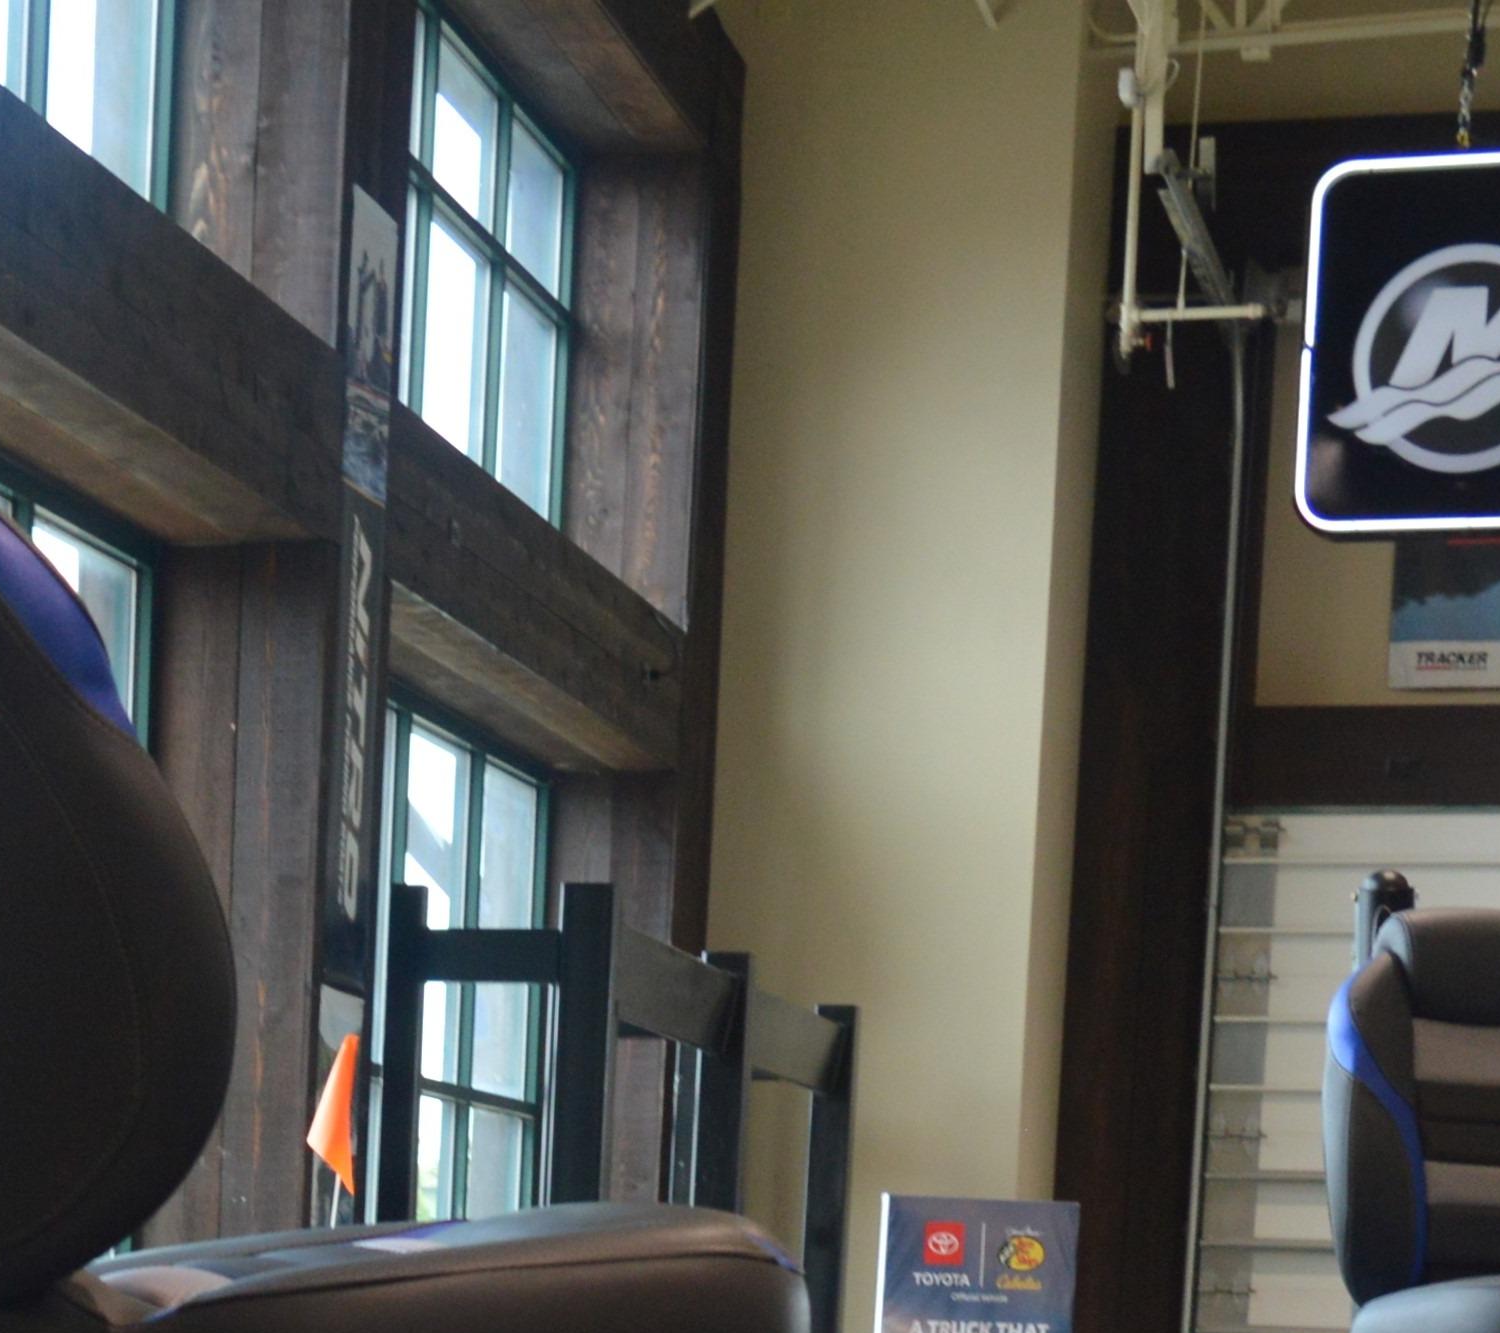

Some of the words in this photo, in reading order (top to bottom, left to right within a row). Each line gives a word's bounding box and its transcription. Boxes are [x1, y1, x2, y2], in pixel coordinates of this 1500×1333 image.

[1416, 651, 1488, 666] TRACKER
[343, 528, 372, 923] NITRO
[912, 1271, 970, 1287] TOYOTA
